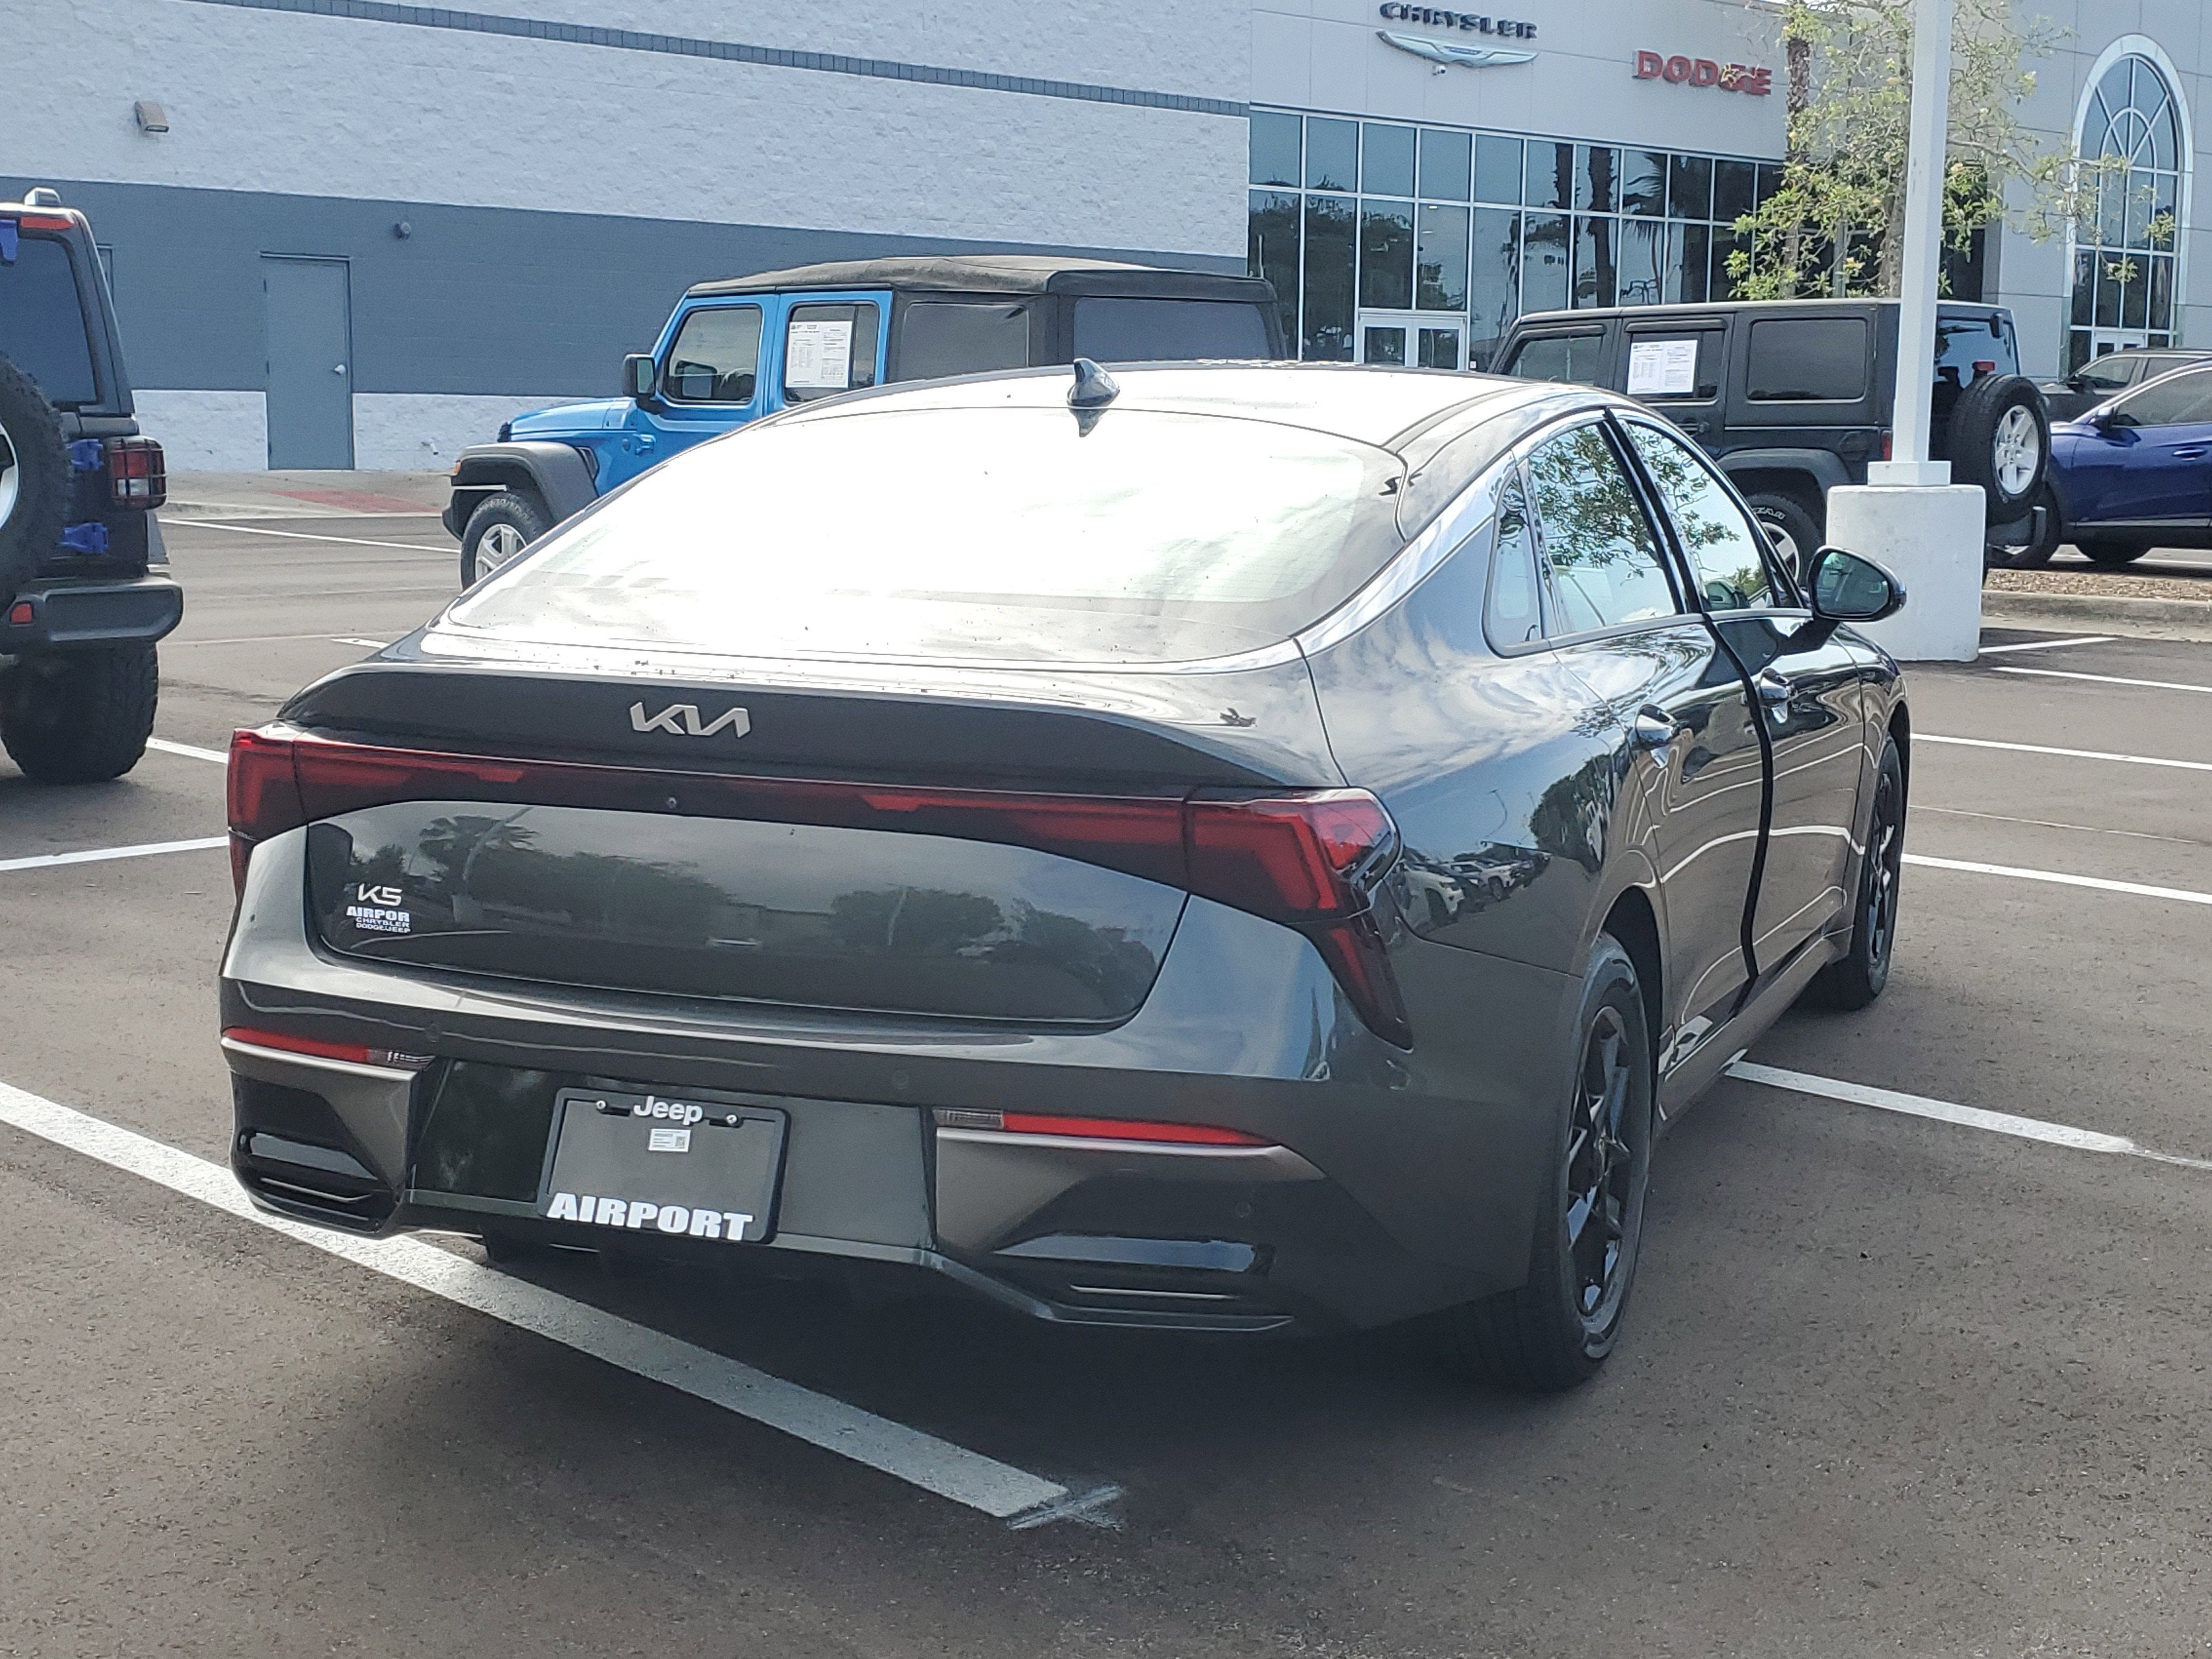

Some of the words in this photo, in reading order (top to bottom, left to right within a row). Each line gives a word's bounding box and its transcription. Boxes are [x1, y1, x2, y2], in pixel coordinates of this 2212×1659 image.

[1379, 2, 1537, 38] CHRYSLER
[630, 702, 751, 738] KIA
[358, 883, 403, 906] K5
[346, 906, 410, 922] AIRPOR
[633, 1096, 703, 1125] Jeep
[546, 1192, 754, 1240] AIRPORT
